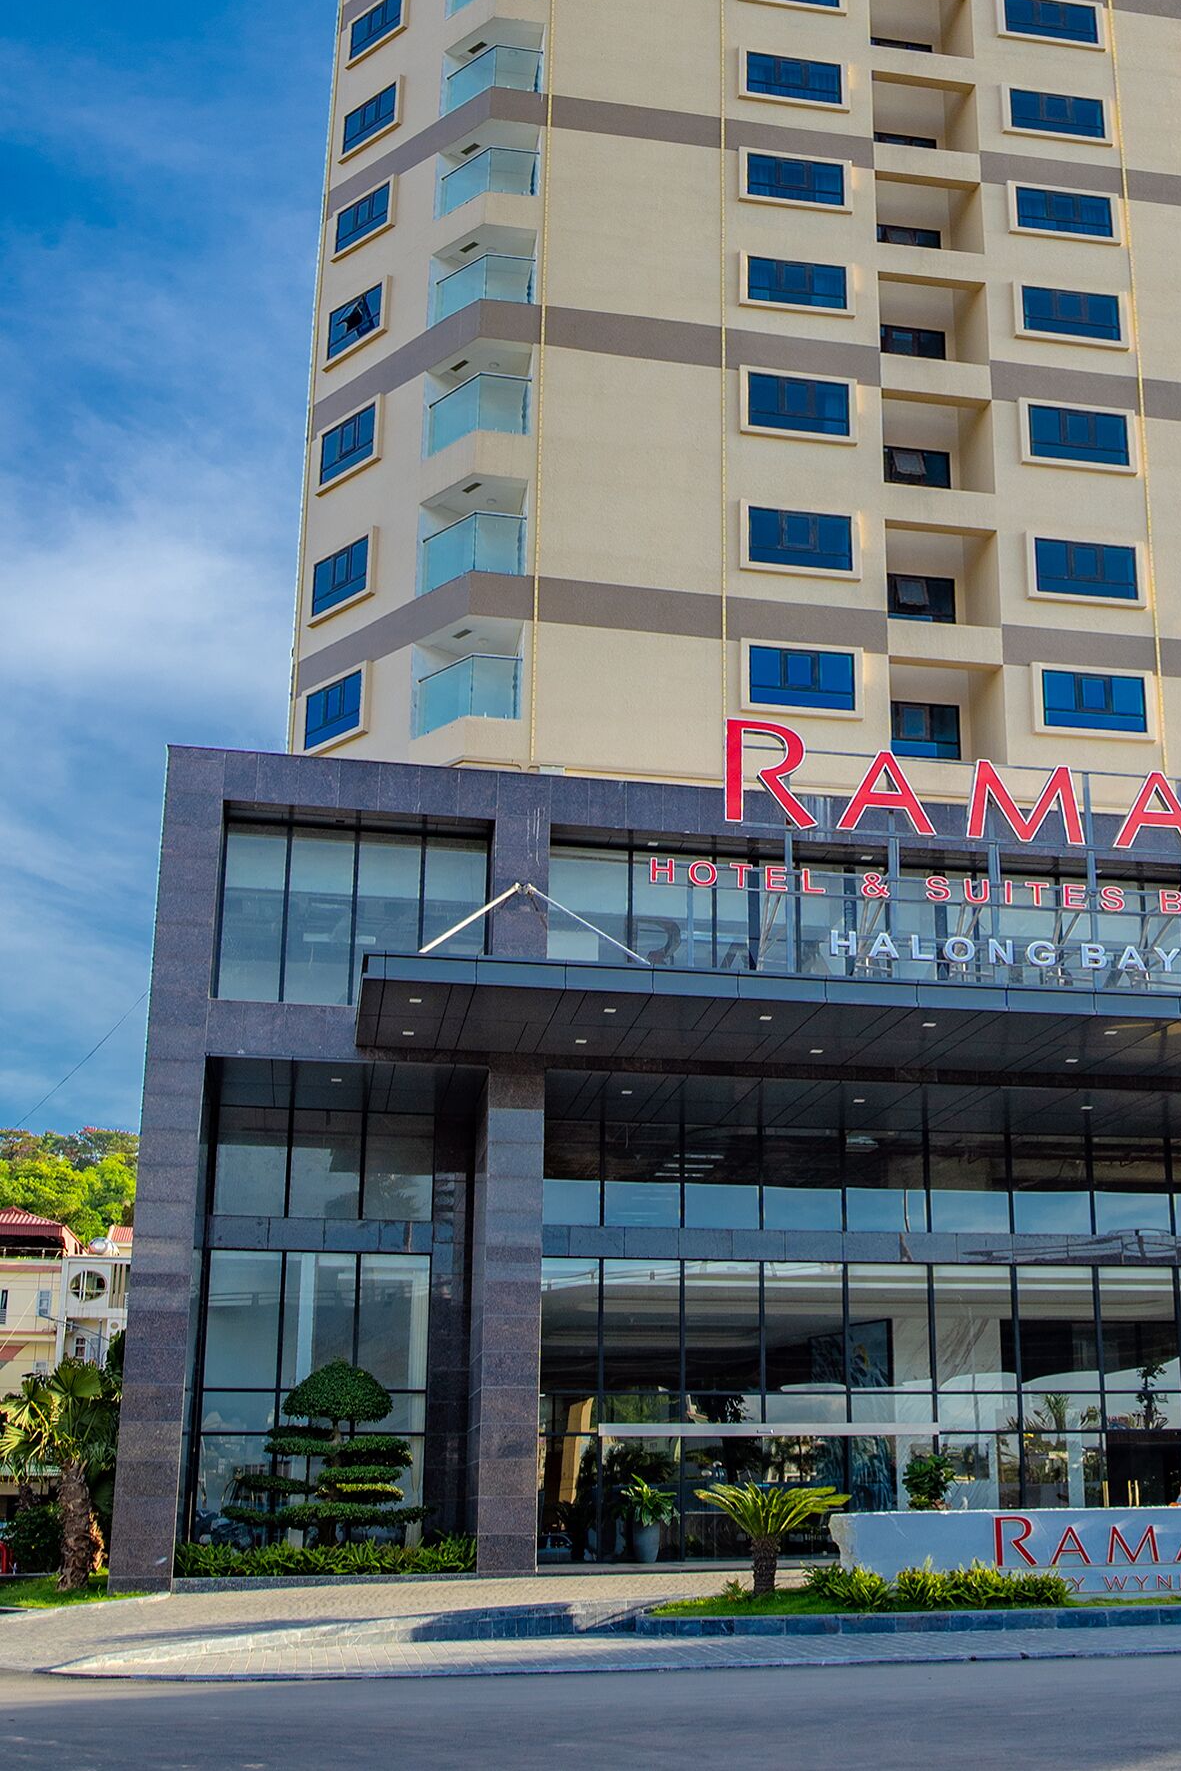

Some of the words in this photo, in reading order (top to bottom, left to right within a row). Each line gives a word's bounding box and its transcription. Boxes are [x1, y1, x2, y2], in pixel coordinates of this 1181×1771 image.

[650, 857, 826, 894] HOTEL
[860, 871, 890, 899] &
[925, 875, 1126, 912] SUITES
[829, 929, 1058, 968] HALONG
[1080, 942, 1180, 973] BAY
